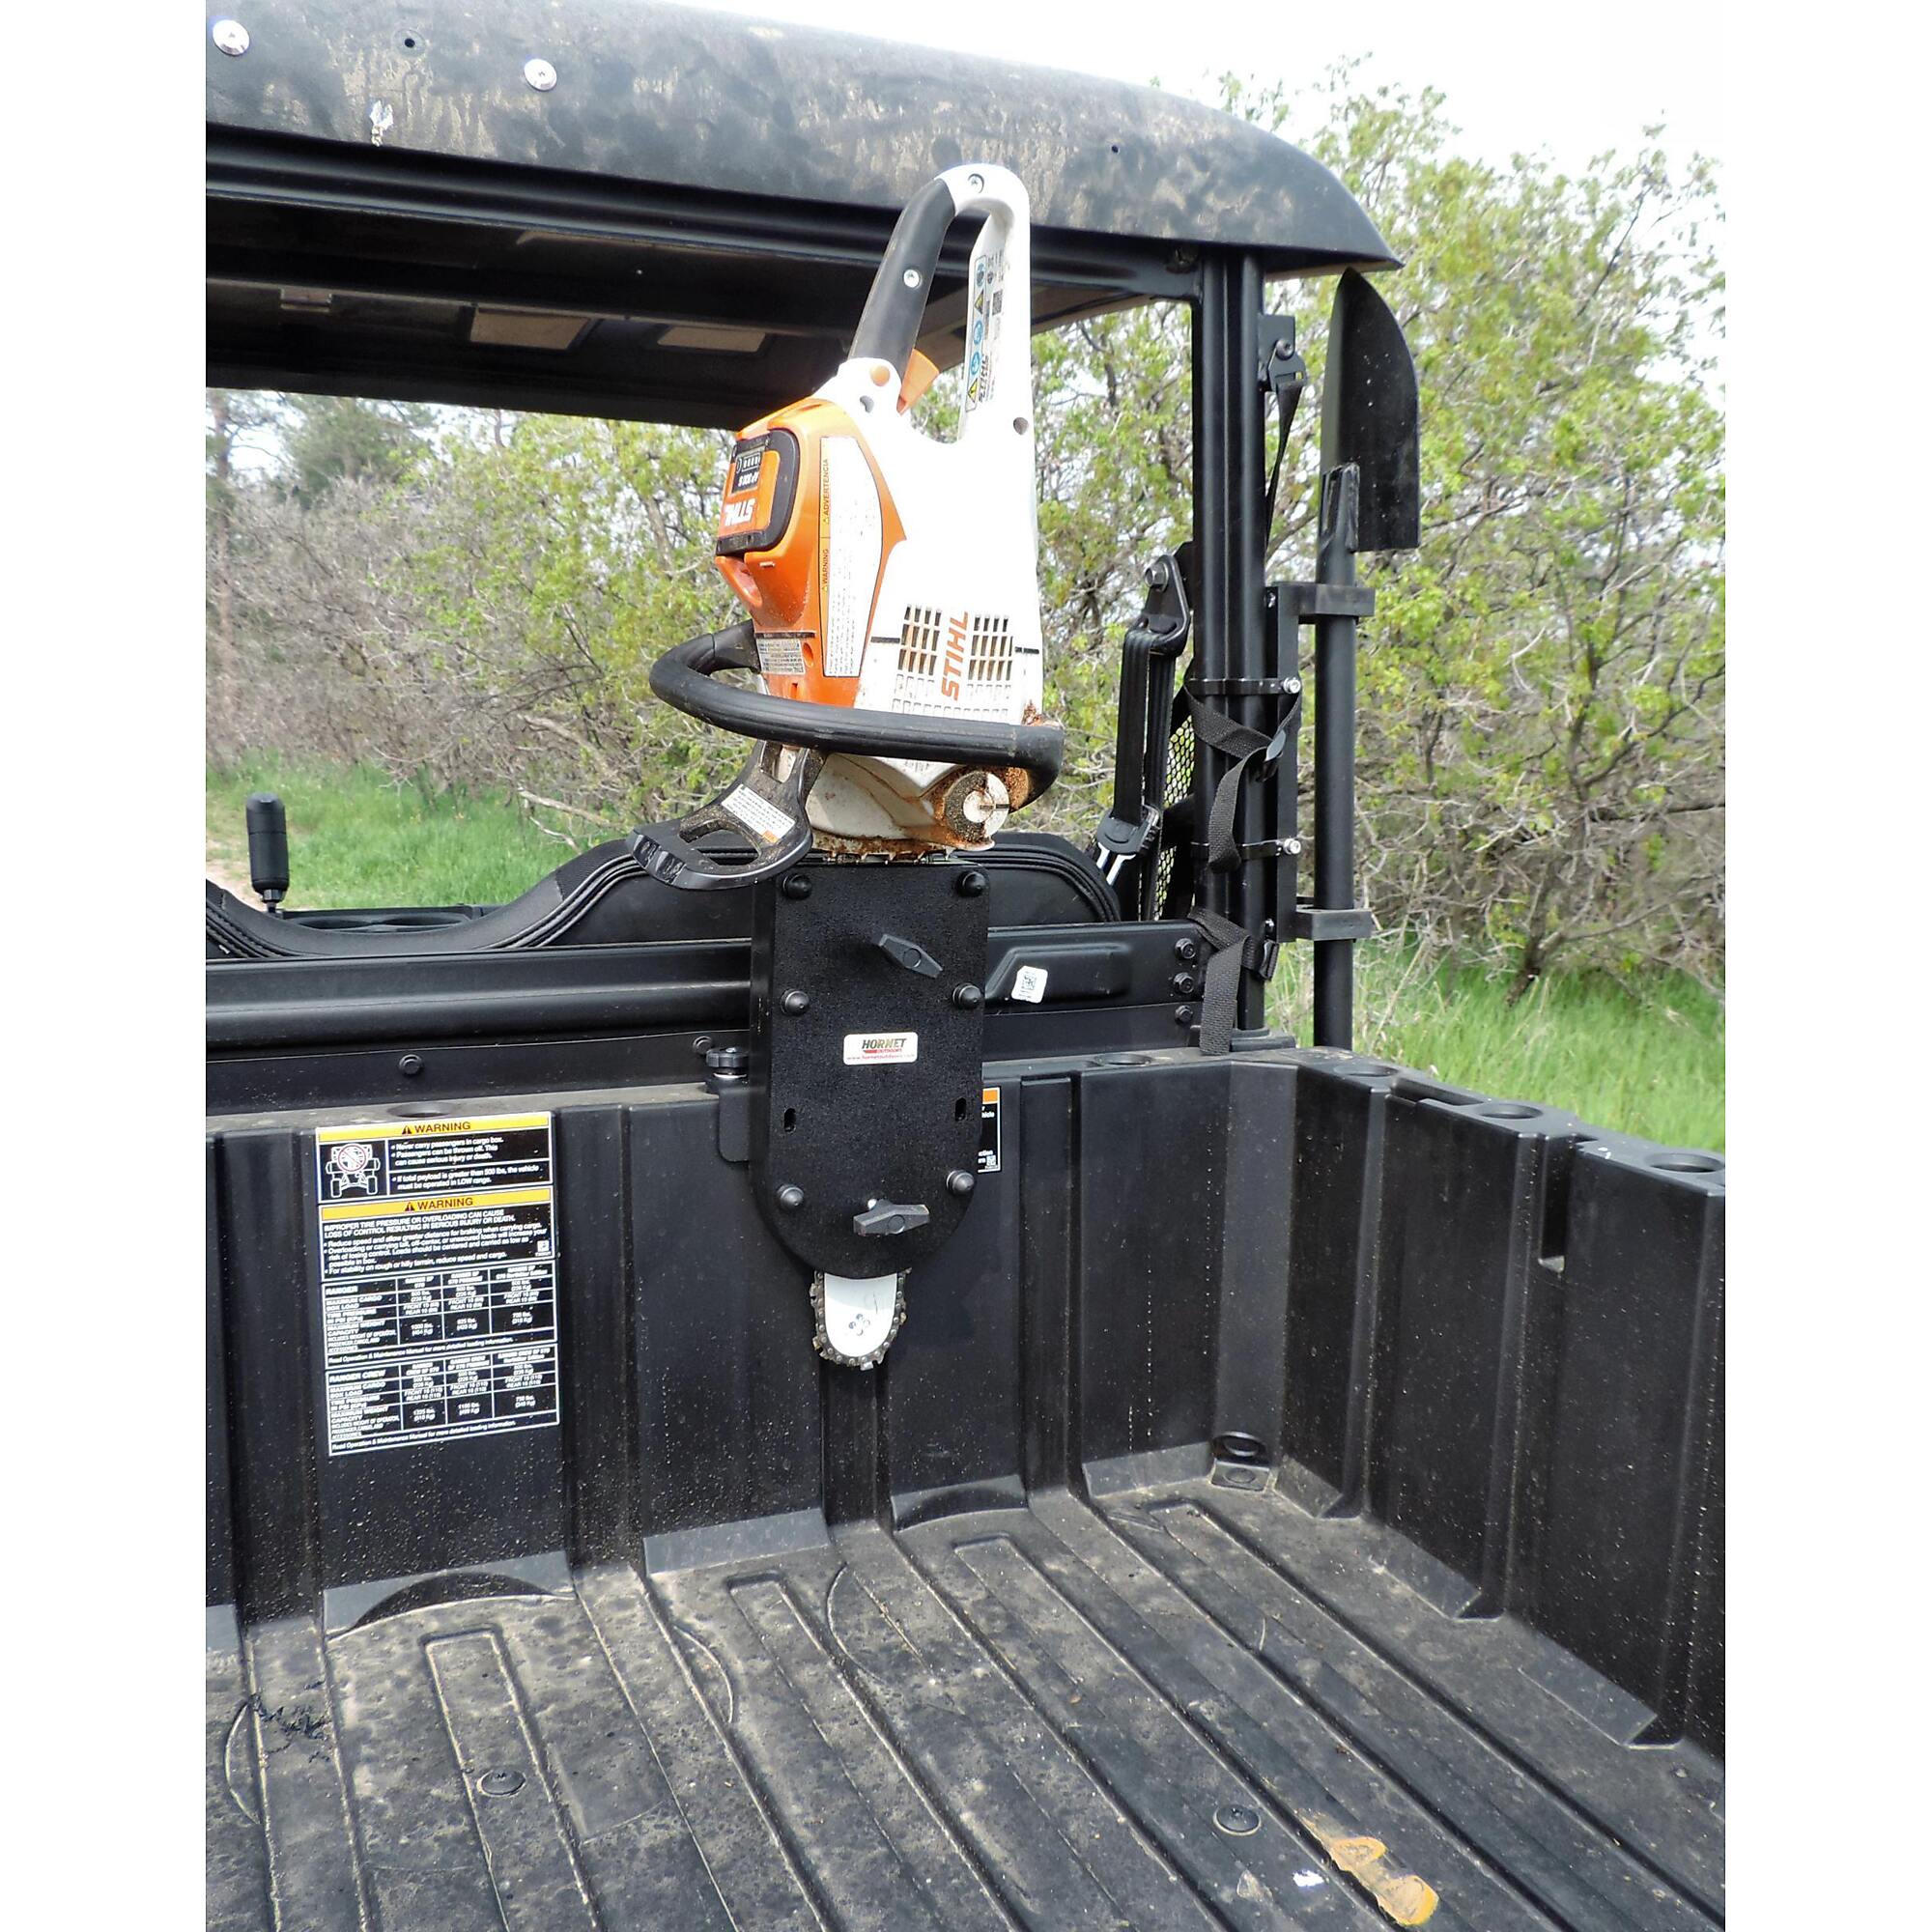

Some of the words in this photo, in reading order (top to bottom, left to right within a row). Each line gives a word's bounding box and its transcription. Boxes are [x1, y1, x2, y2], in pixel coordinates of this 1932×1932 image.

[941, 611, 969, 701] STIHL
[862, 1038, 907, 1049] HORNET
[414, 1122, 471, 1134] WARNING
[417, 1197, 473, 1210] WARNING
